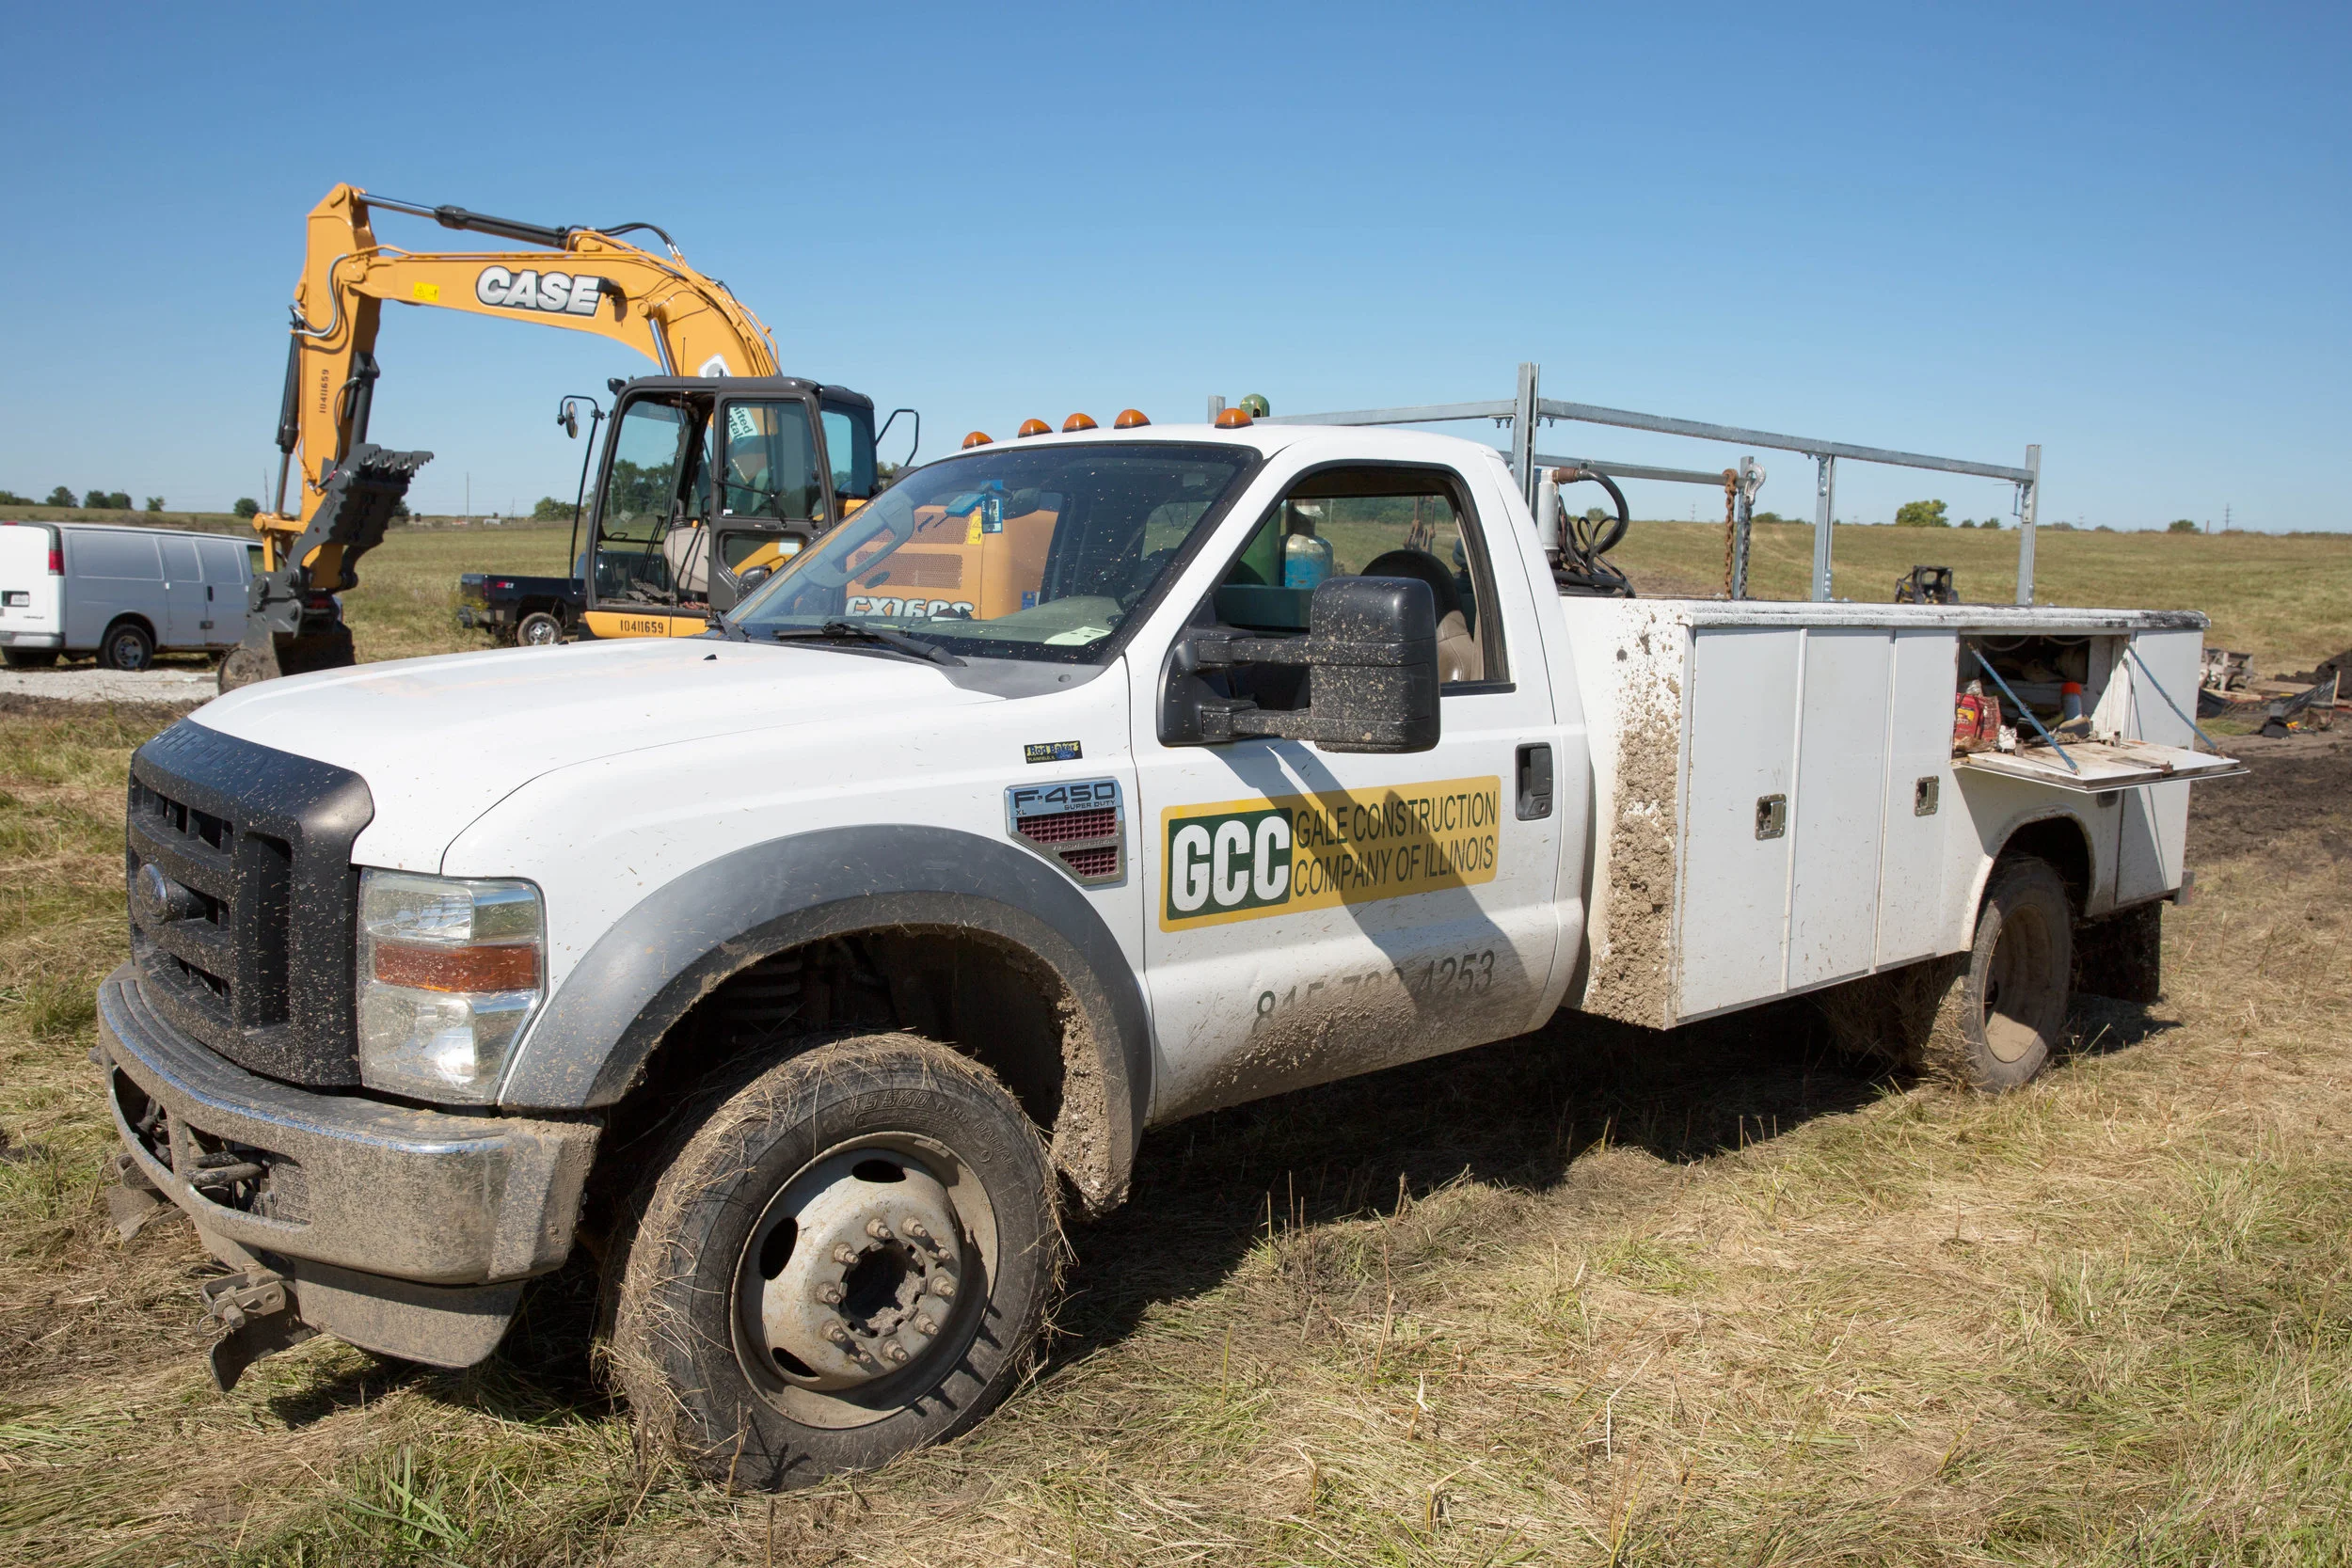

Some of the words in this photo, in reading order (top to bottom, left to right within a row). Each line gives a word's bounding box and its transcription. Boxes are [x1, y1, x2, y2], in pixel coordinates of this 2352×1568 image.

[476, 265, 601, 316] CASE
[319, 369, 329, 414] 10411659
[620, 619, 664, 634] 10411659
[1029, 744, 1047, 755] Rod
[1049, 742, 1075, 753] Baker
[1064, 802, 1091, 811] SUPER
[1093, 800, 1117, 808] DUTY
[1295, 805, 1348, 849] GALE
[1353, 790, 1497, 844] CONSTRUCTION
[1171, 815, 1291, 912] GCC
[1295, 849, 1395, 897] COMPANY
[1395, 845, 1421, 882] OF
[1423, 834, 1494, 879] ILLINOIS
[1419, 949, 1496, 1001] 4253
